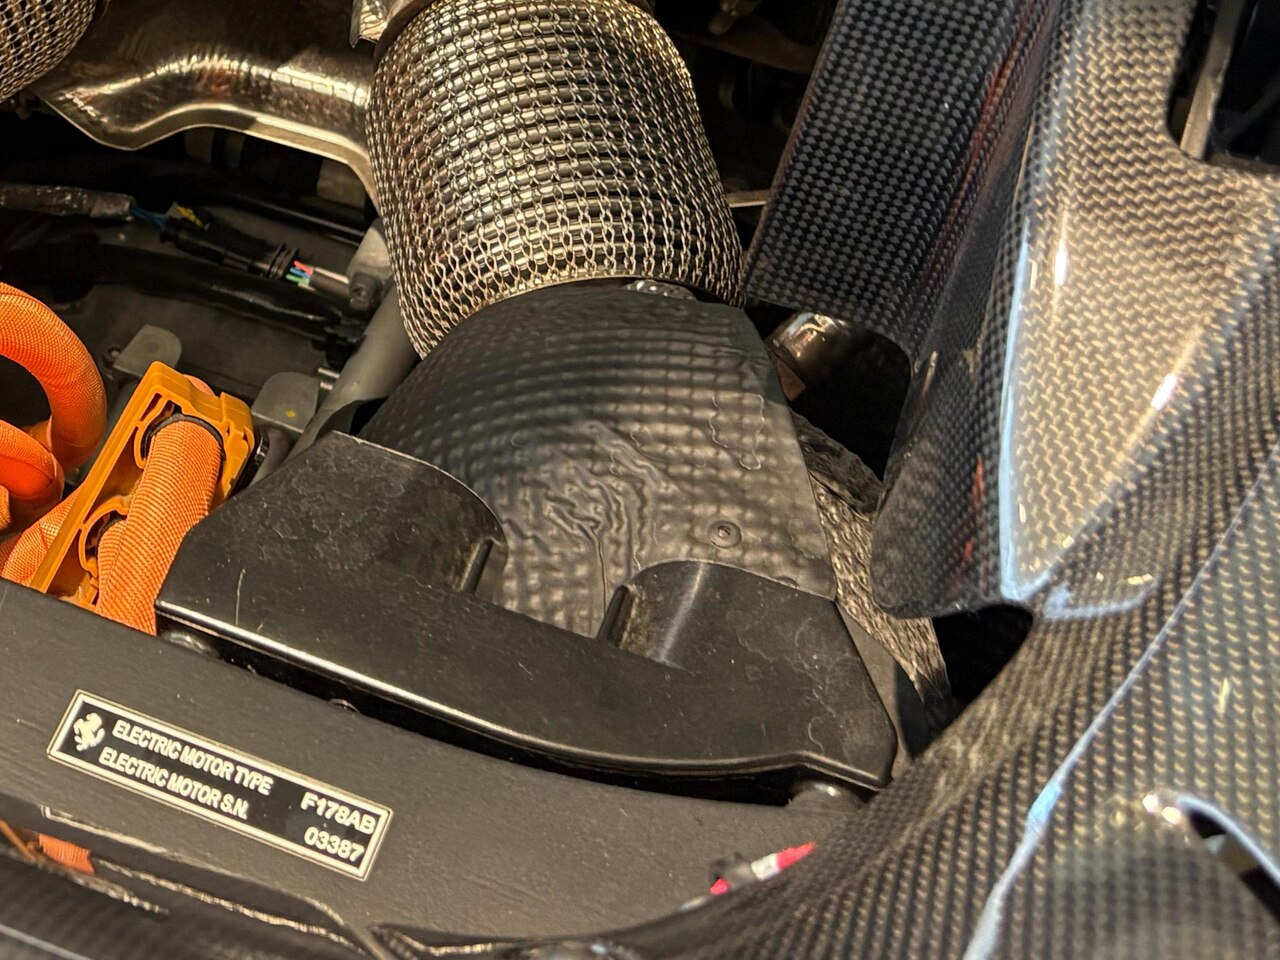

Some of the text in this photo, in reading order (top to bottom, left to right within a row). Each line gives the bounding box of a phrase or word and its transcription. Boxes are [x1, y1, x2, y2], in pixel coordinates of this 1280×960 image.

[98, 746, 366, 864] ELECTRIC MOTOR S.N. 03387
[111, 719, 378, 836] ELECTRIC MOTOR TYPE F178AB
